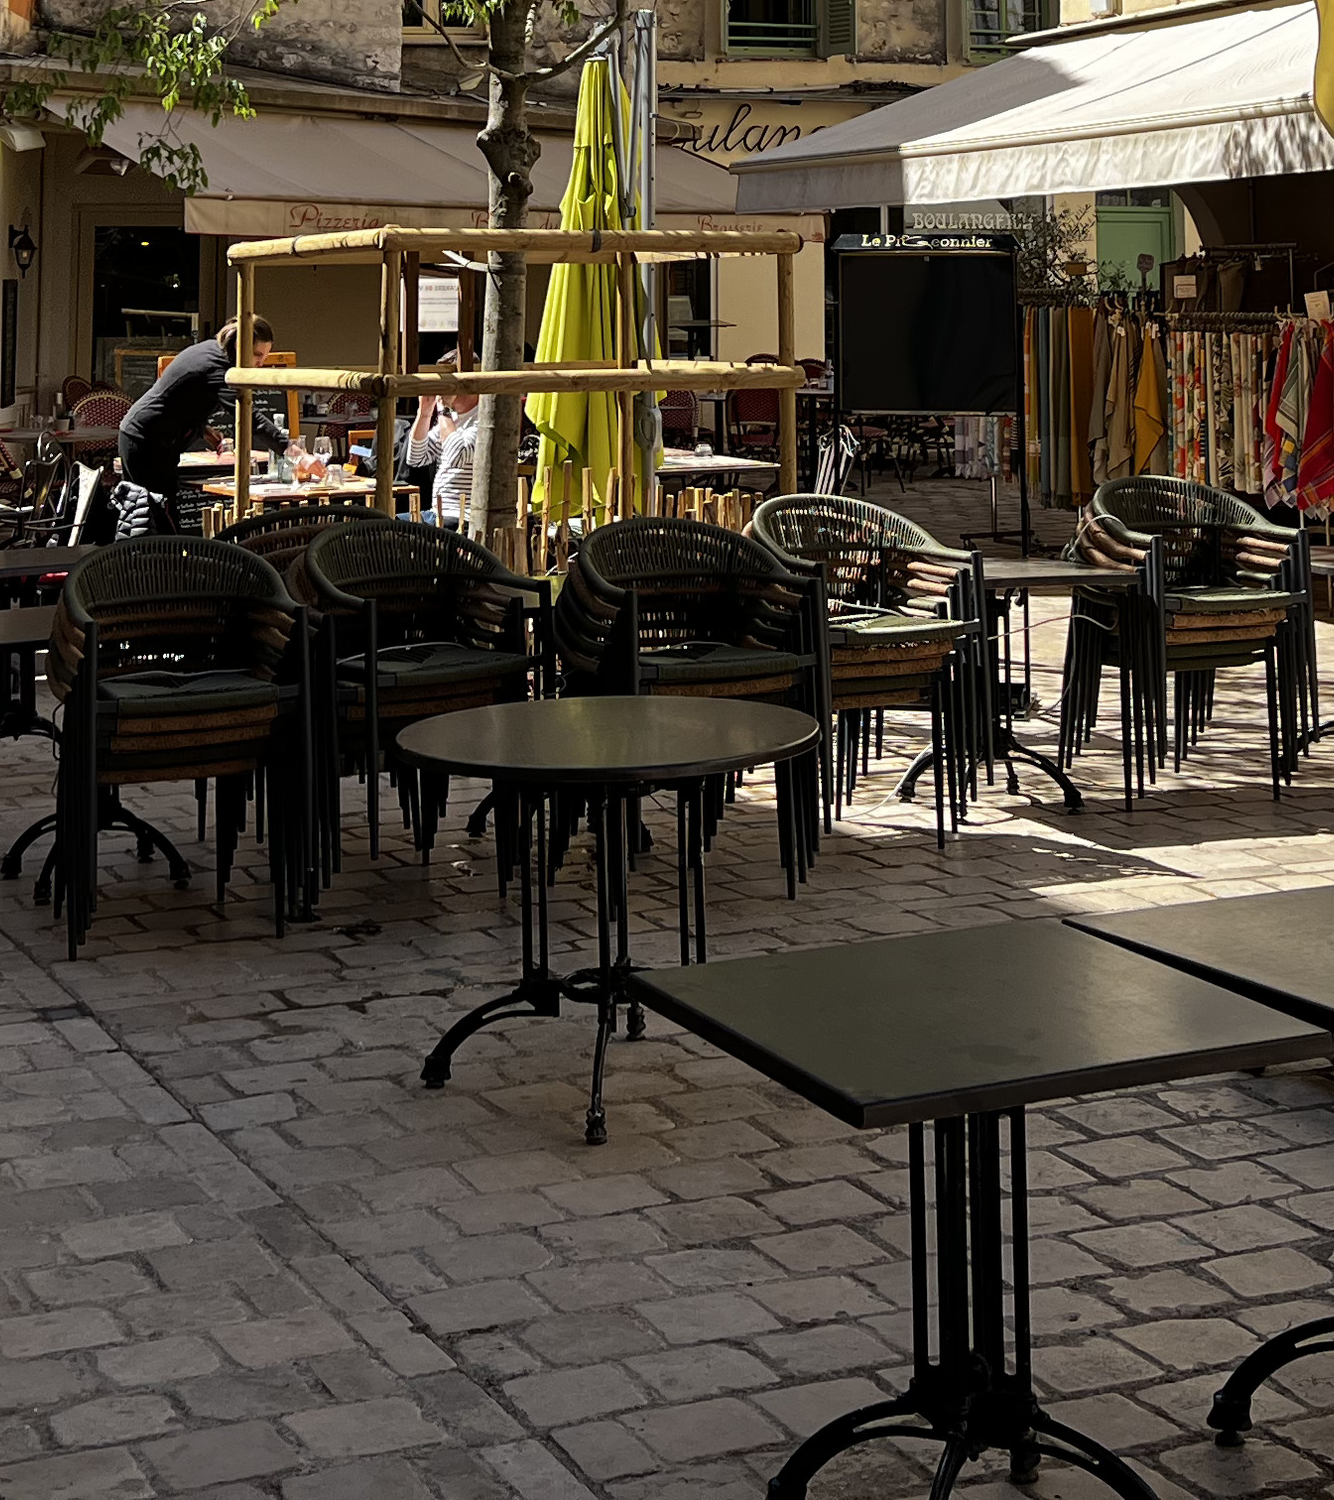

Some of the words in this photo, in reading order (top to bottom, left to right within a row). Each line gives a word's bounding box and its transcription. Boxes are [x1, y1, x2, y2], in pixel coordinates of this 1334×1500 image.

[289, 204, 380, 230] Pizzeria
[912, 212, 1033, 230] BOULANGER
[861, 234, 881, 247] Le
